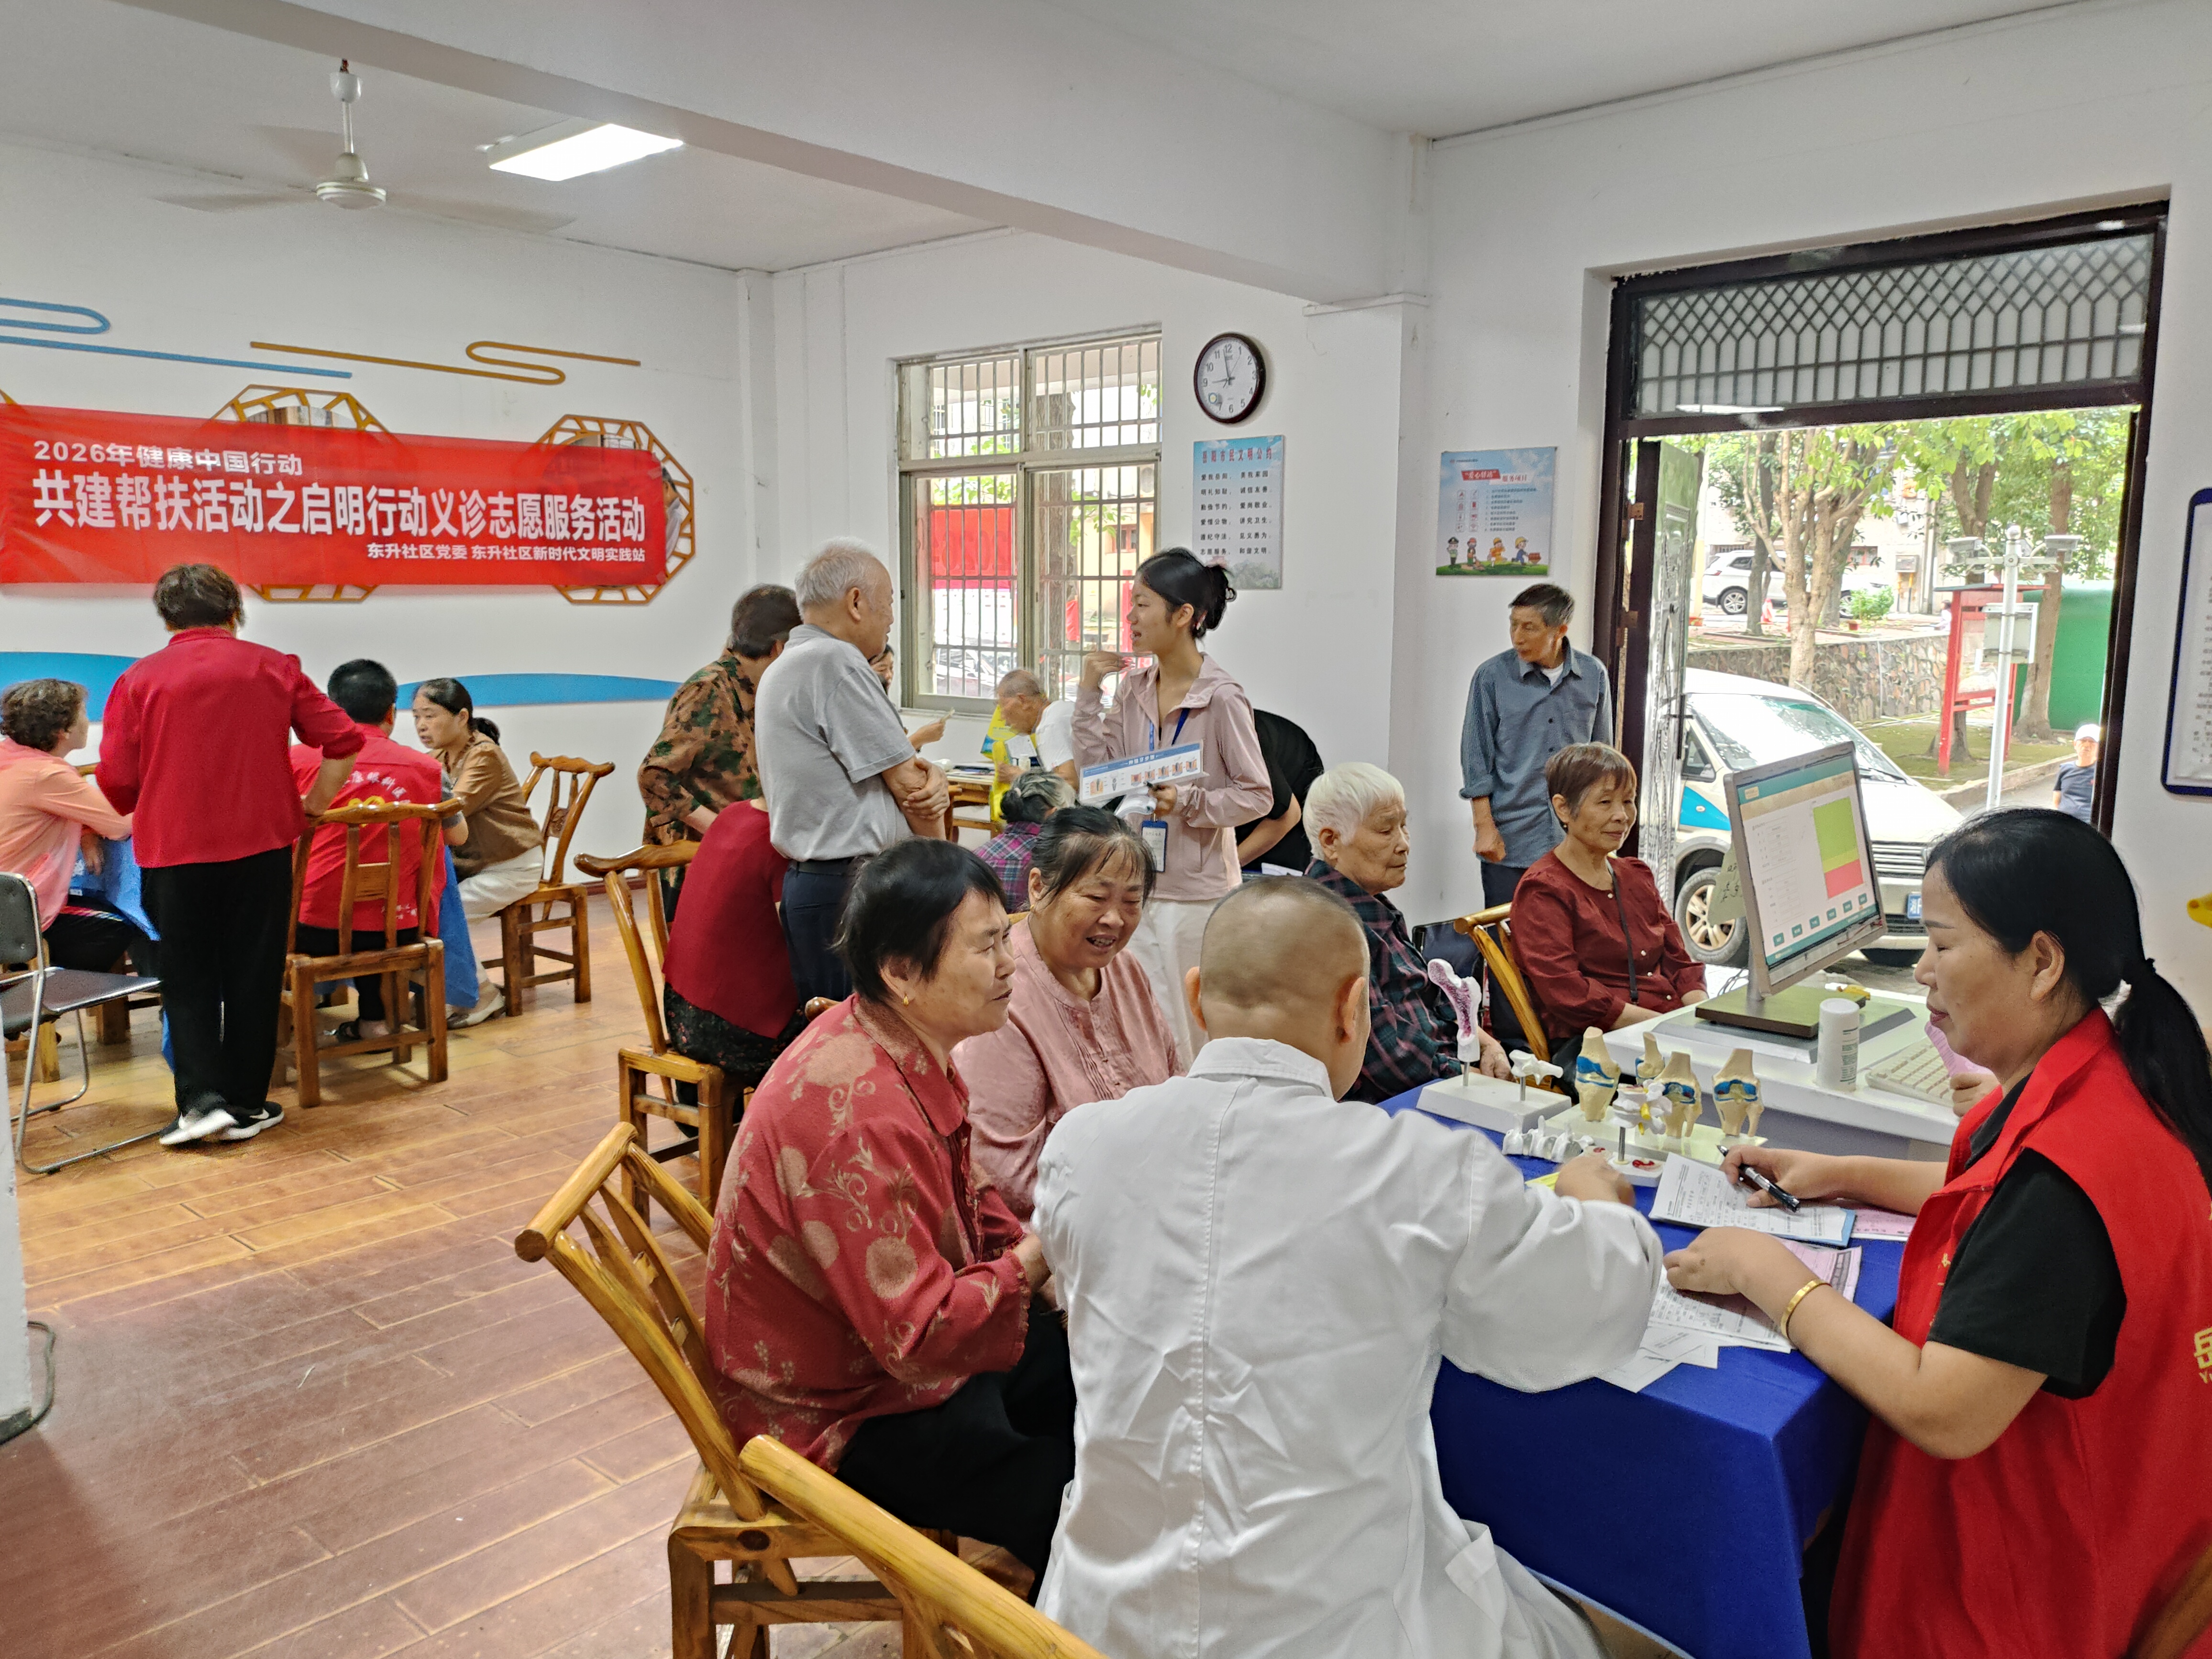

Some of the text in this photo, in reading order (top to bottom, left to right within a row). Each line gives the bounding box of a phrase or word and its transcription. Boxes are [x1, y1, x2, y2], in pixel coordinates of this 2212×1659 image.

[1225, 343, 1232, 353] 12
[1239, 346, 1241, 355] 1
[1215, 350, 1220, 358] 11
[1248, 356, 1252, 365] 2
[1206, 362, 1214, 372] 10
[1252, 371, 1257, 380] 3
[1203, 378, 1207, 387] 9
[1240, 398, 1245, 407] 5
[1228, 404, 1233, 413] 6
[34, 440, 303, 476] 2026年健康中国行动
[33, 468, 645, 542] 共建帮扶活动之启明行动义诊志愿服务活动
[367, 542, 645, 563] 东升社区党委 东升社区新时代文明实践站
